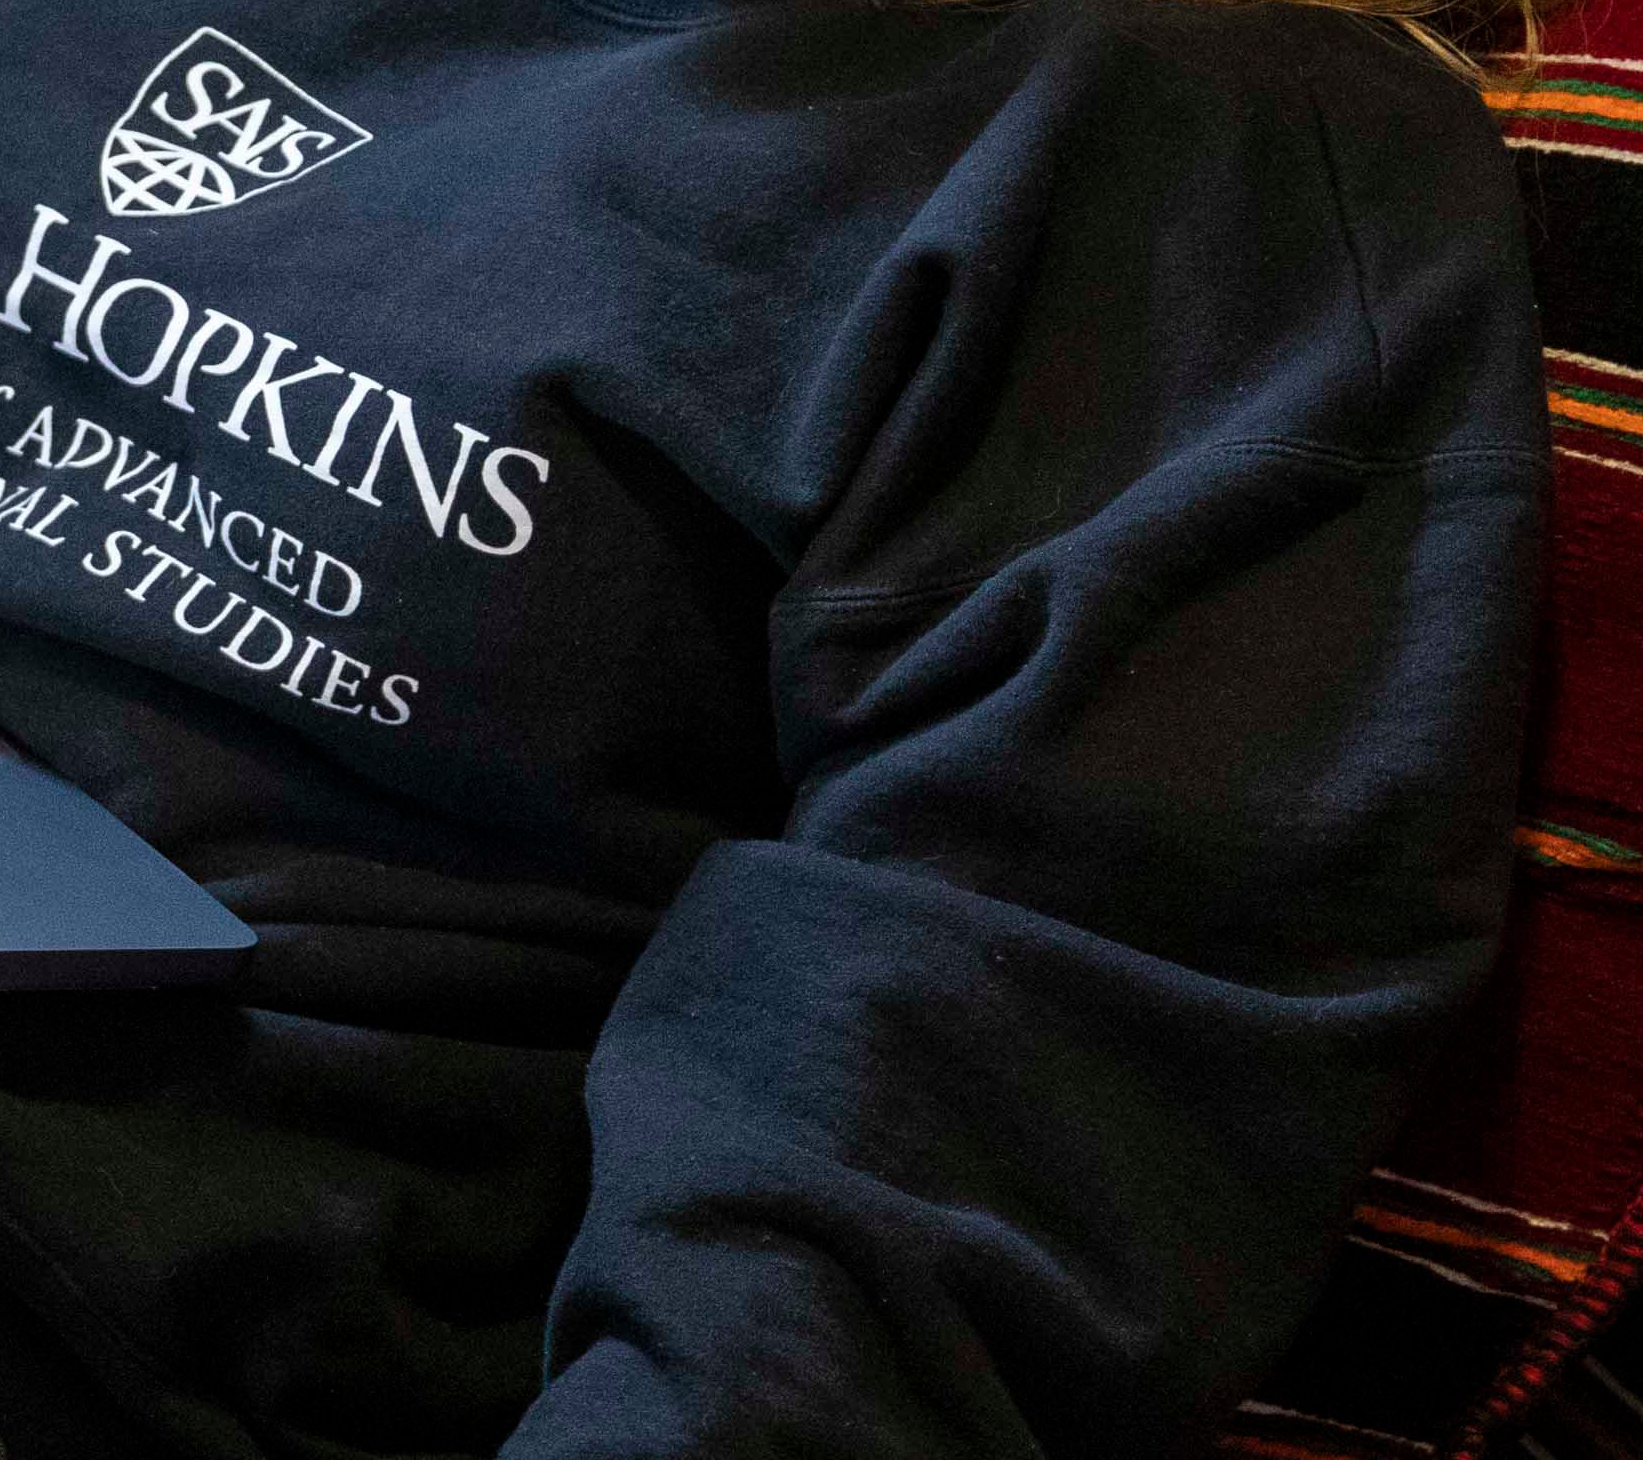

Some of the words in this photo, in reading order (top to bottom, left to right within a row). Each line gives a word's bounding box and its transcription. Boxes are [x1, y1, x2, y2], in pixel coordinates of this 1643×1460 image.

[150, 59, 336, 180] SAIS
[6, 404, 363, 620] ADVANCED
[82, 528, 421, 730] STUDIES
